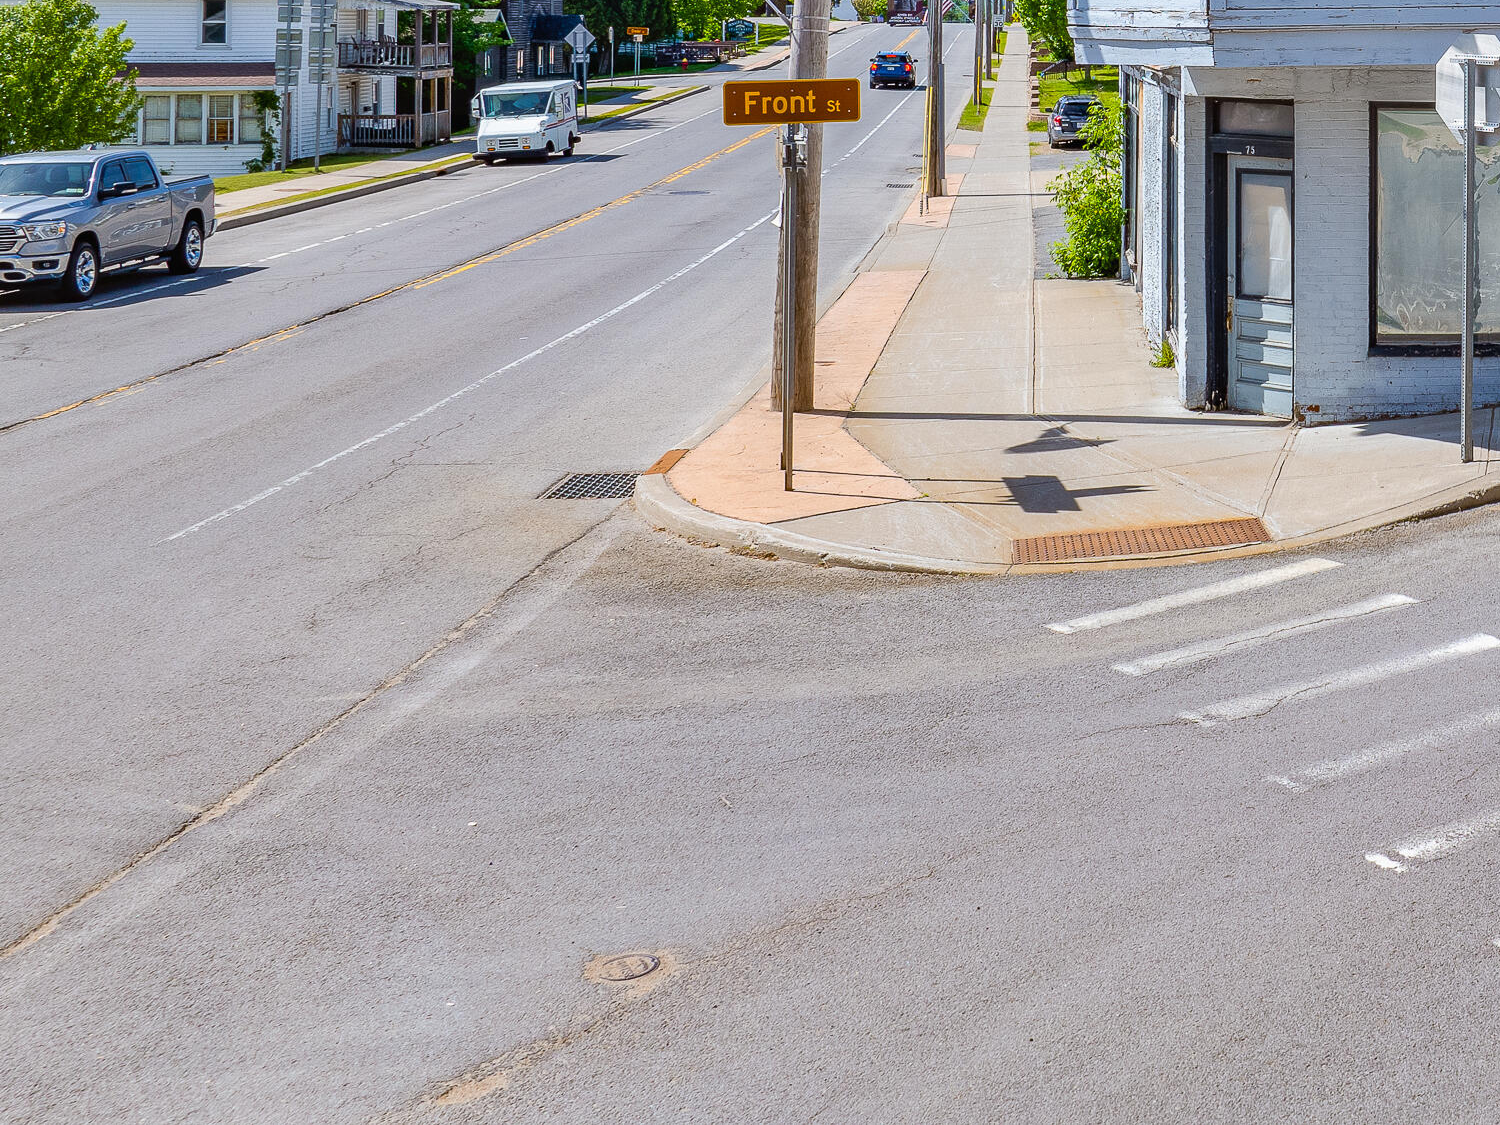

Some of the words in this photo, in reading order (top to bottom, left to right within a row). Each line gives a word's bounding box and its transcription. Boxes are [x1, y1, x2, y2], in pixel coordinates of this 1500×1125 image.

[744, 90, 816, 115] Front
[826, 100, 841, 113] St
[1245, 145, 1255, 155] 75
